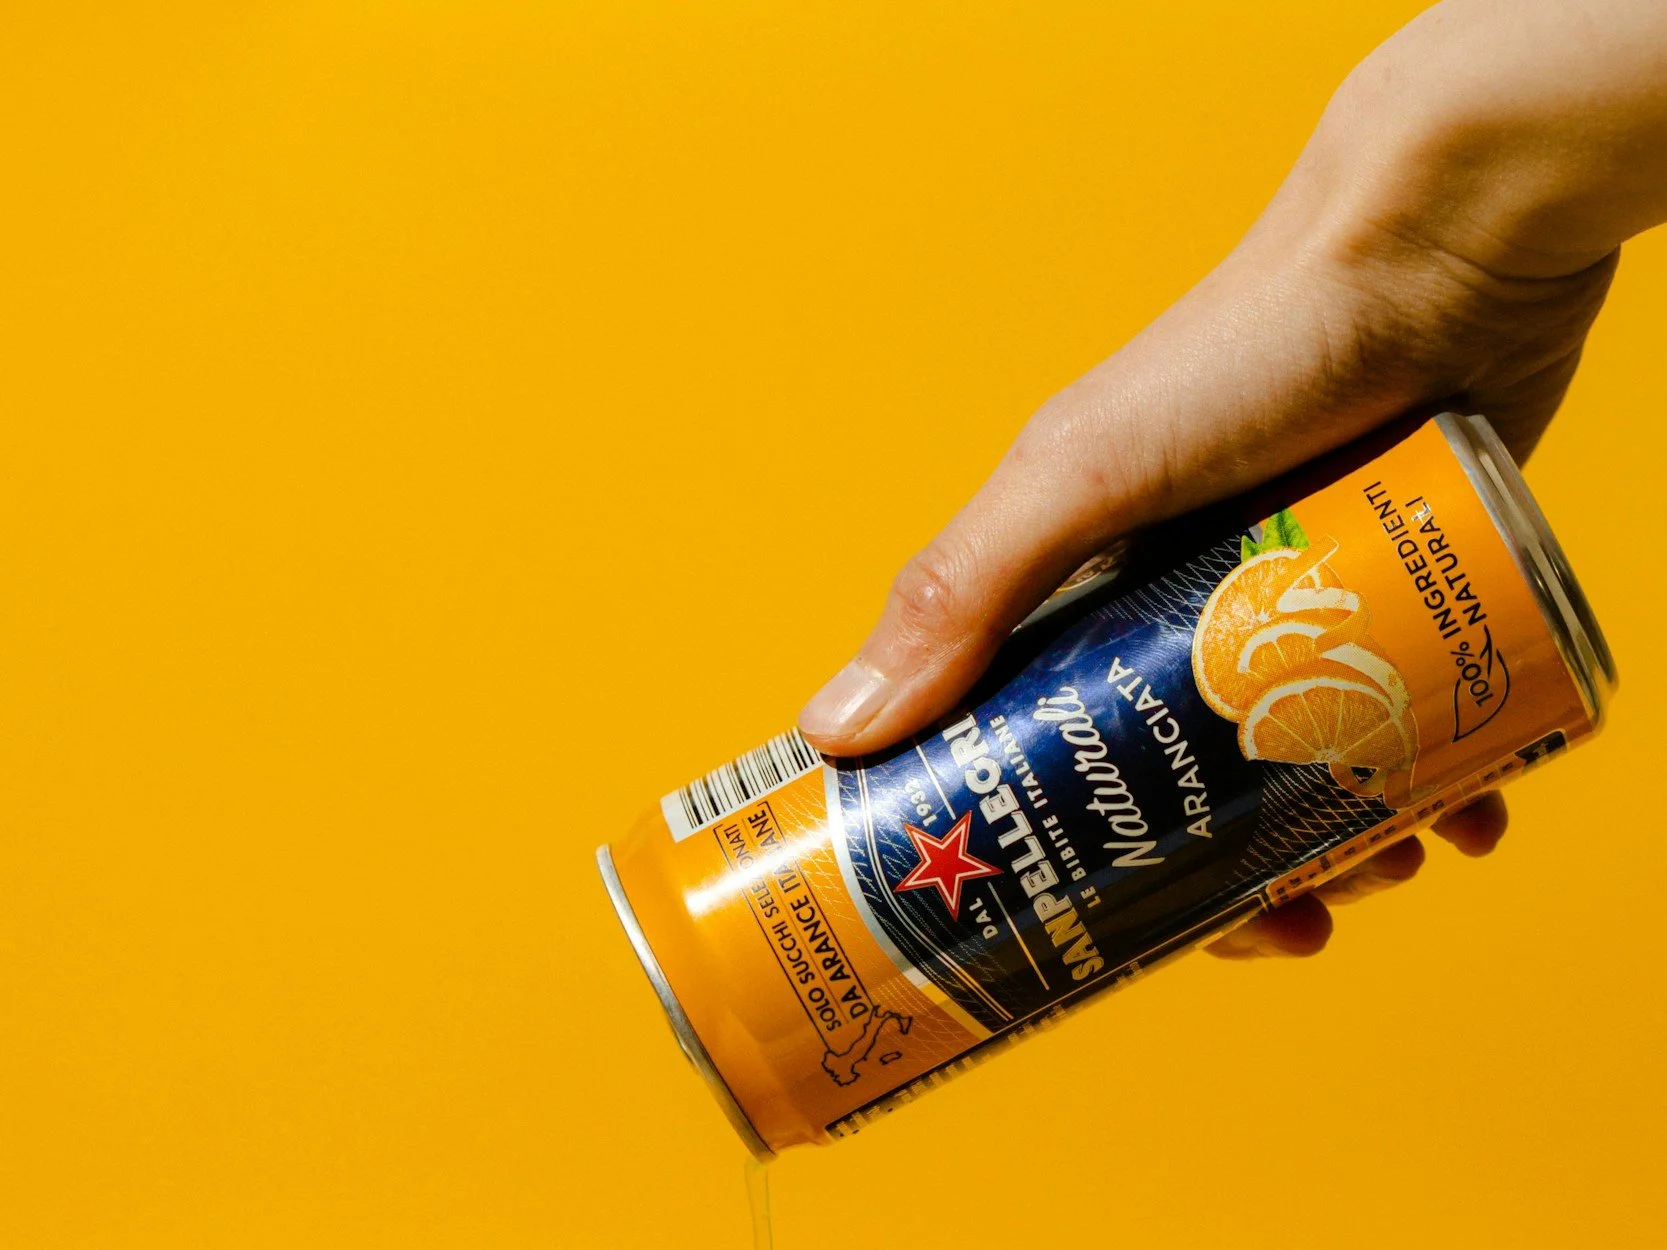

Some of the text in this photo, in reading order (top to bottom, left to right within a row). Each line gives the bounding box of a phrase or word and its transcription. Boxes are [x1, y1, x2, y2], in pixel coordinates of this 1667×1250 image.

[1363, 481, 1462, 640] INGREDIENTI
[1405, 495, 1487, 626] NATURALI
[1450, 641, 1494, 707] 100%
[1032, 686, 1165, 868] Naturali
[1106, 656, 1213, 839] ARANCIATA
[989, 714, 1102, 910] LE BIBITE ITALIANE
[770, 920, 816, 985] SUCCHI
[788, 894, 851, 983] ARANCE
[968, 896, 999, 940] DAL
[807, 986, 842, 1032] SOLO
[840, 984, 870, 1020] DA
